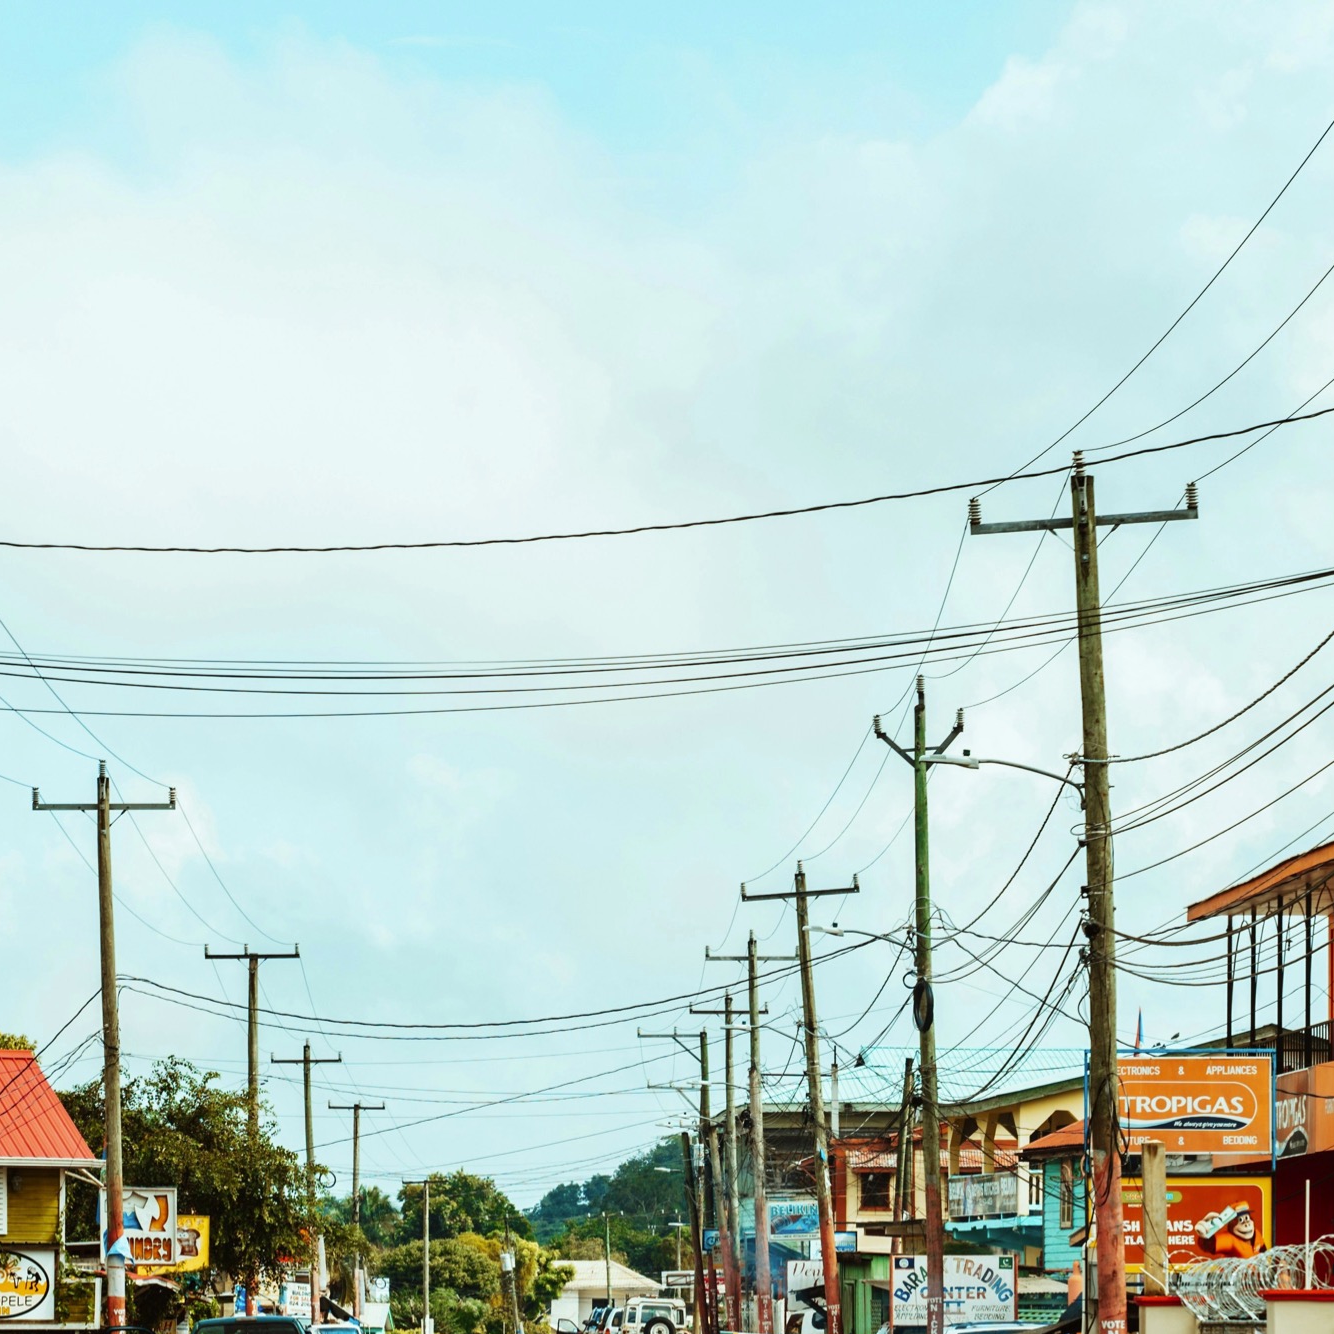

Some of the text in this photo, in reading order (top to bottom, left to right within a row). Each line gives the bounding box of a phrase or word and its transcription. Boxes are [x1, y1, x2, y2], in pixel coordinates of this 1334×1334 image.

[1117, 1065, 1257, 1075] ECTRONICS & APPLIANCES
[1119, 1096, 1244, 1114] TROPIGAS
[1178, 1137, 1185, 1145] &
[1223, 1136, 1258, 1145] BEDDING
[771, 1203, 818, 1216] BELIKIN
[1123, 1220, 1193, 1232] SH ANS
[1169, 1235, 1195, 1245] HERE
[953, 1257, 1014, 1303] TRADING
[920, 1286, 987, 1300] CNTER
[894, 1304, 927, 1313] ELECTRON
[974, 1313, 1006, 1321] BEDDING
[1101, 1320, 1125, 1330] VOTE
